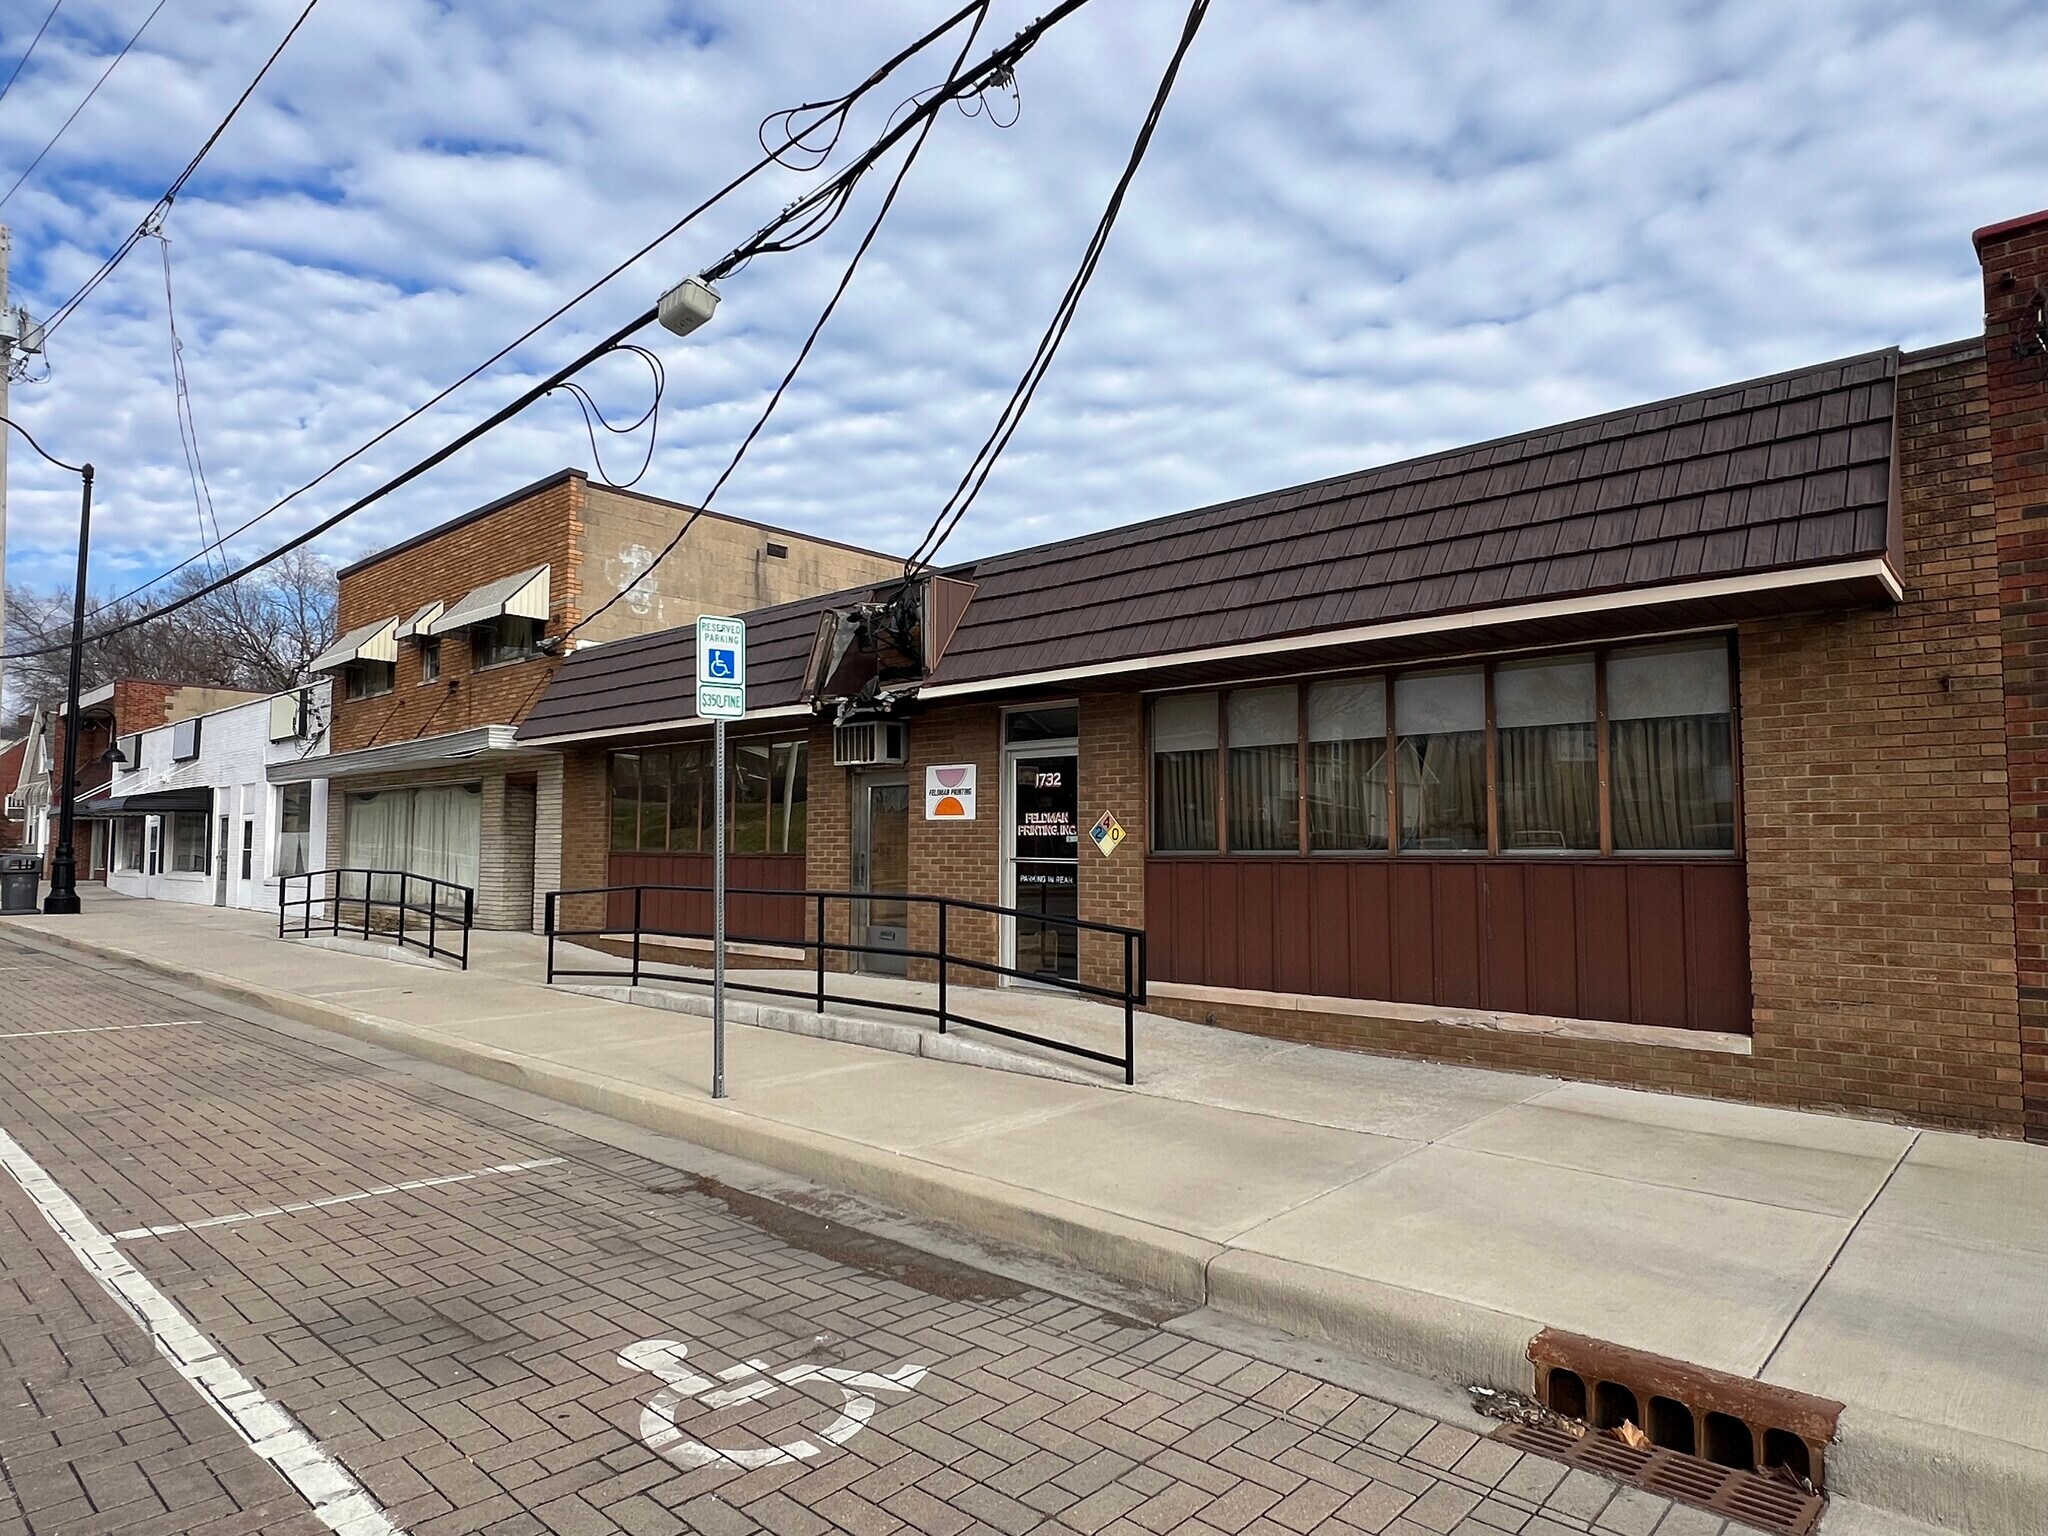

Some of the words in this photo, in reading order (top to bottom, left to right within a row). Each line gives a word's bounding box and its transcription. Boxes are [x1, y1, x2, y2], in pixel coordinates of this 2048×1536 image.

[702, 622, 741, 635] RESERVED
[704, 633, 739, 645] PARKING
[702, 693, 722, 707] $350
[723, 695, 741, 708] FINE
[1035, 772, 1062, 788] 1732
[1025, 812, 1069, 824] FELDMAN
[1103, 816, 1110, 829] 4
[1095, 827, 1103, 840] 2
[1055, 875, 1074, 884] REAR
